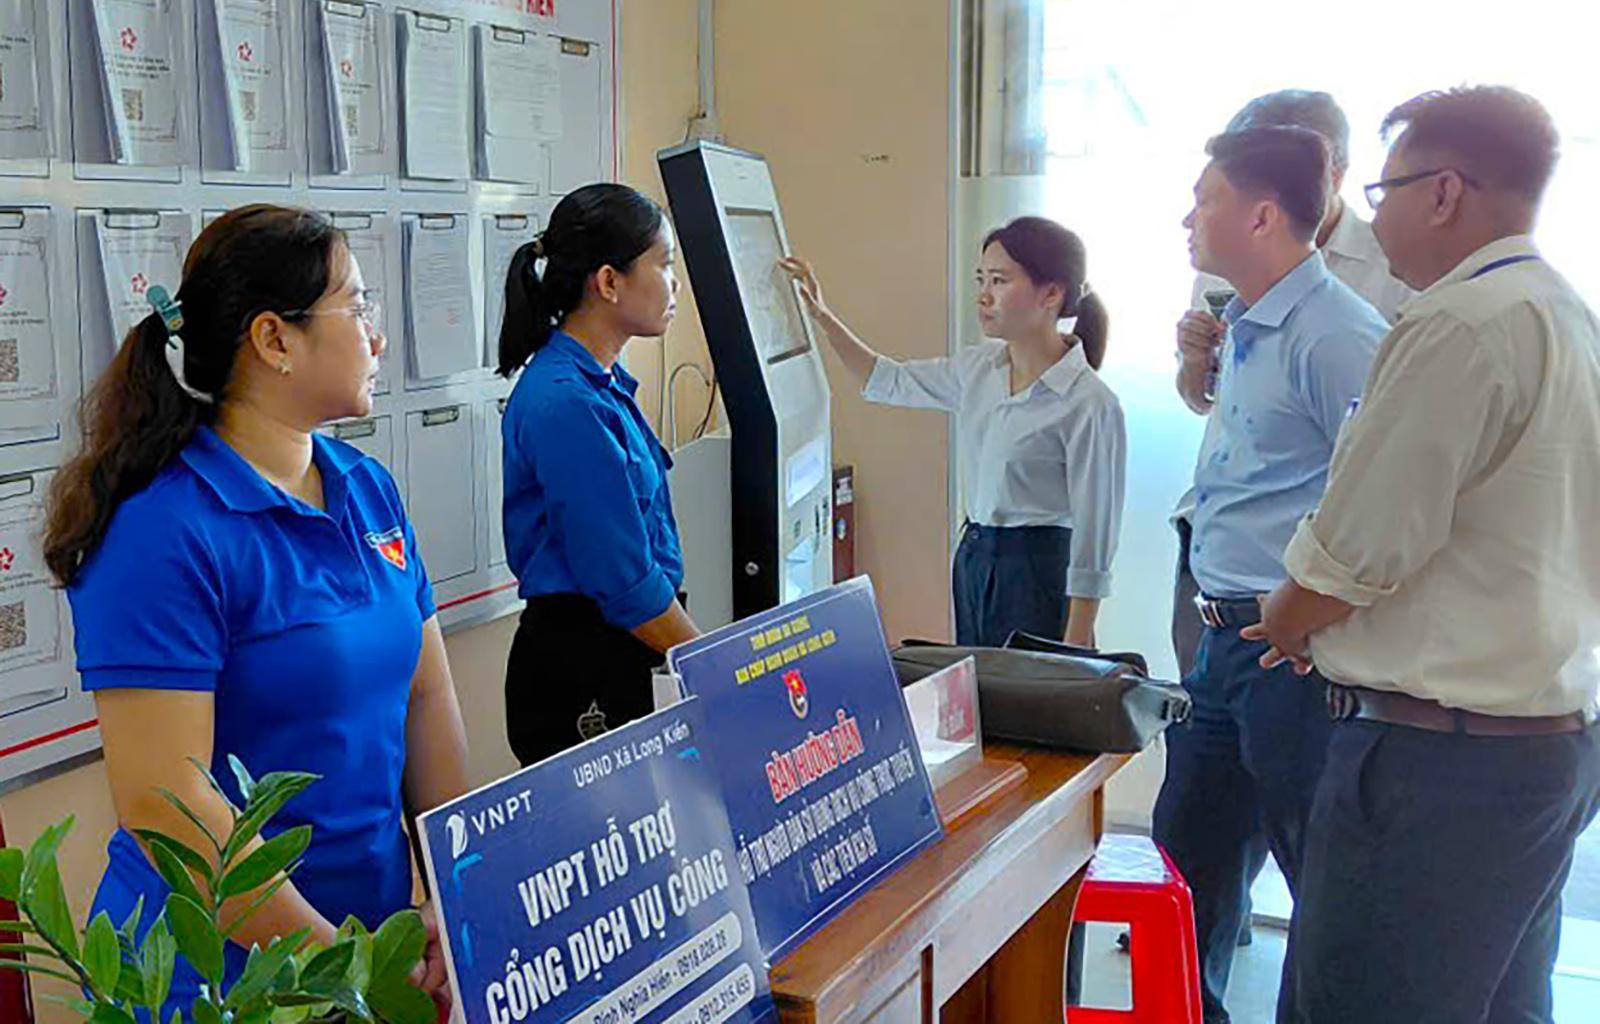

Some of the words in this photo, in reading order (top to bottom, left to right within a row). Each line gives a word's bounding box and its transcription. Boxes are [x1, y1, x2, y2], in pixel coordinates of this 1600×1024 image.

[573, 754, 613, 788] UBND
[614, 748, 632, 772] Xã
[634, 735, 664, 761] Long
[662, 719, 690, 749] Kiến
[791, 731, 839, 787] HƯỚNG
[831, 708, 865, 764] DẪN
[471, 790, 533, 836] VNPT
[518, 850, 589, 927] VNPT
[591, 817, 629, 887] HỖ
[628, 800, 677, 864] TRỢ
[486, 948, 568, 1024] CỔNG
[567, 906, 632, 982] DỊCH
[630, 884, 666, 939] VỤ
[667, 849, 729, 917] CÔNG
[619, 985, 649, 1018] Nghĩa
